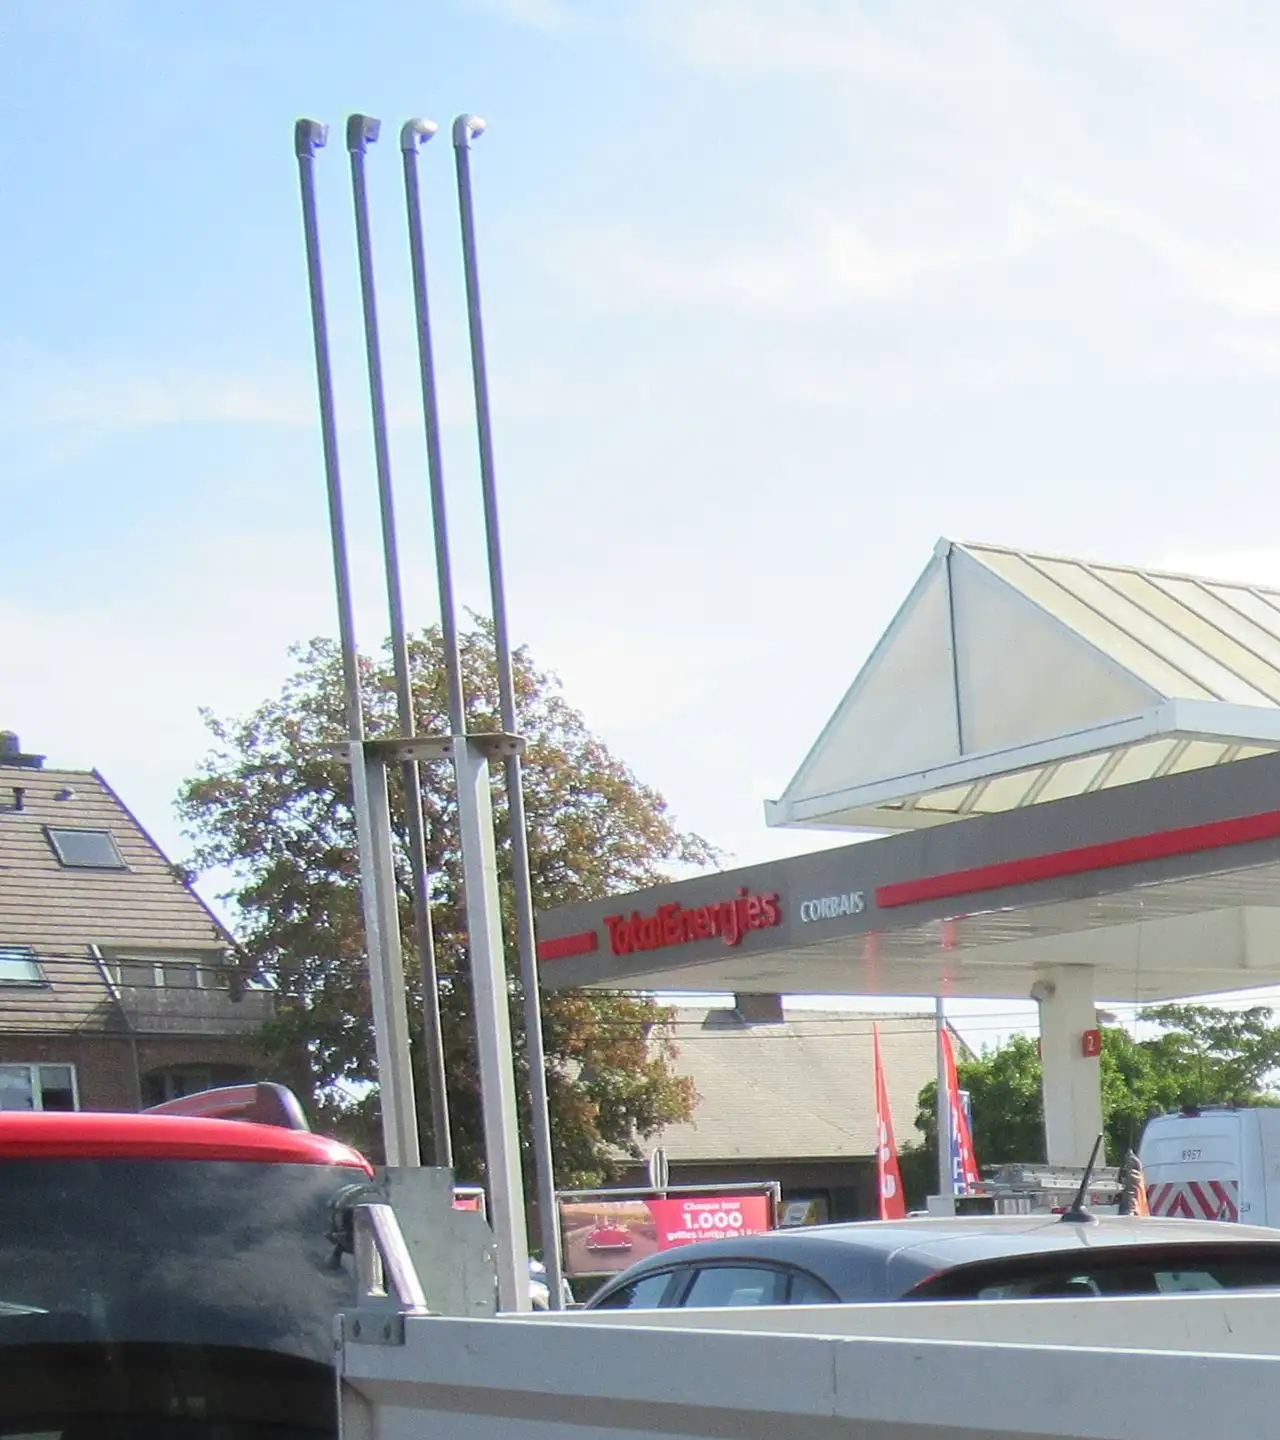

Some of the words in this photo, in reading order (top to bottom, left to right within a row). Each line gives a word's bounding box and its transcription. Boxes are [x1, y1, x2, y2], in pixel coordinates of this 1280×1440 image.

[800, 890, 866, 923] CORBAIS
[603, 887, 782, 956] TotalEnergies
[1087, 1035, 1096, 1051] 2
[1182, 1149, 1201, 1161] 8957
[683, 1202, 720, 1212] Chaque
[682, 1211, 744, 1229] 1.000
